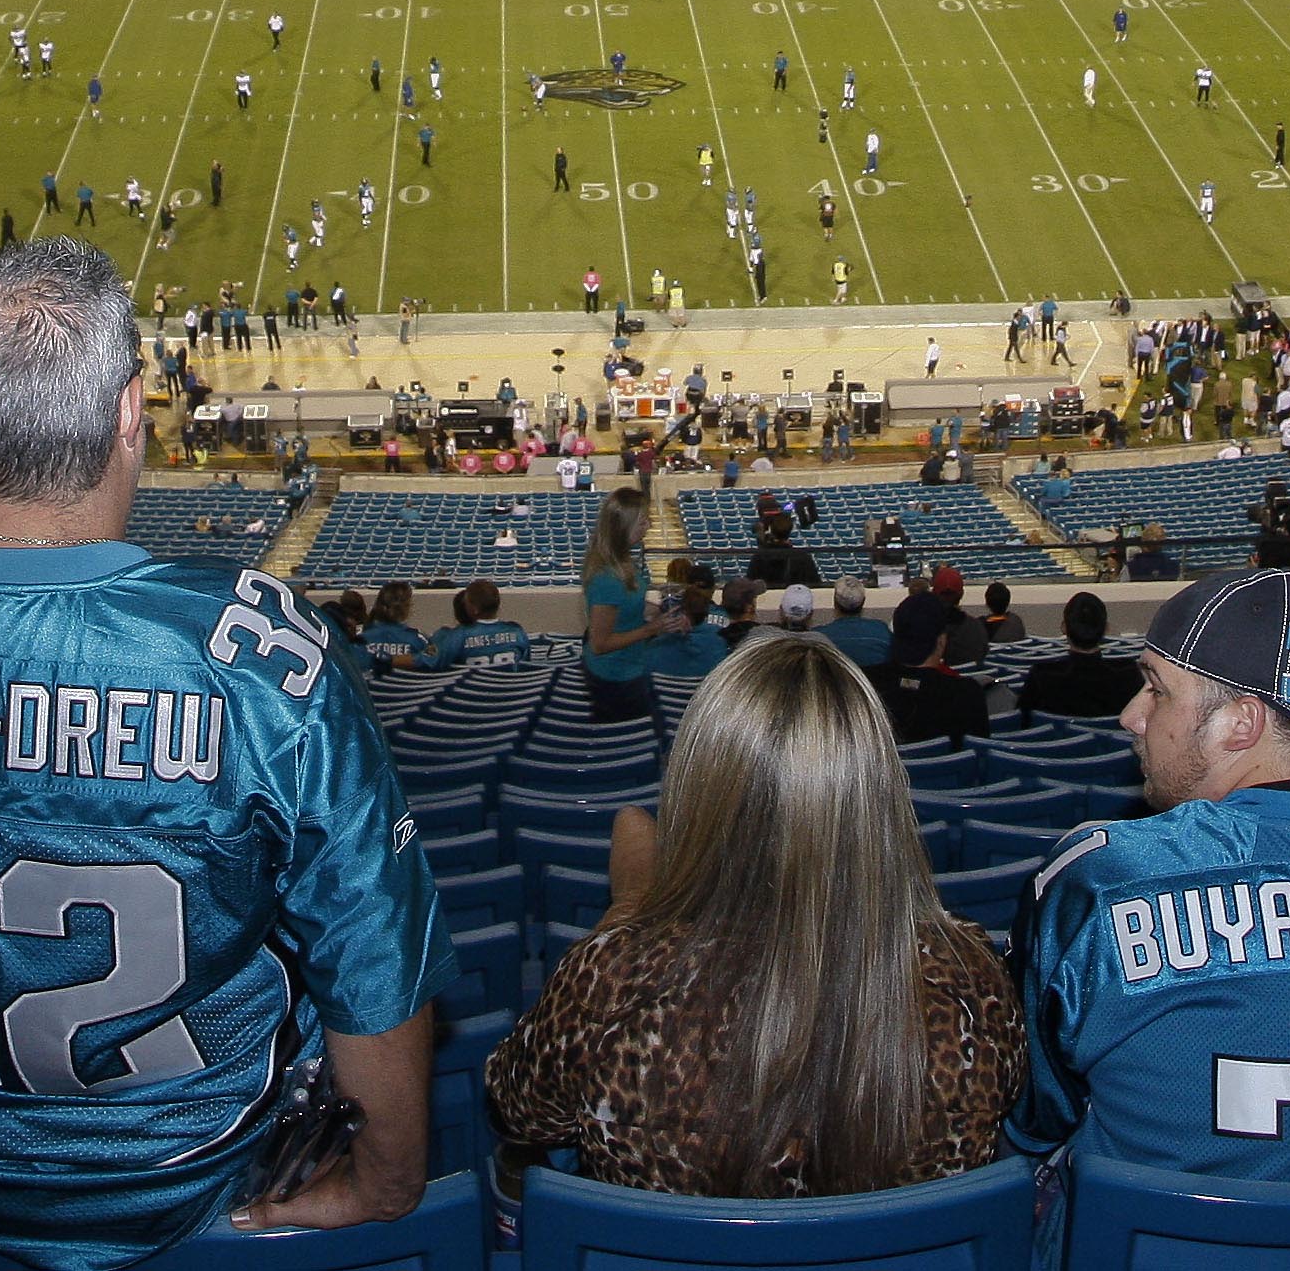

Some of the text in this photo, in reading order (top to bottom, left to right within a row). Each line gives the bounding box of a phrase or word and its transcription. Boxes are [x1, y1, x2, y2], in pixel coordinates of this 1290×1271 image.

[579, 180, 659, 202] 50
[1031, 173, 1111, 194] 30
[209, 568, 329, 697] 32
[1032, 827, 1110, 902] 1
